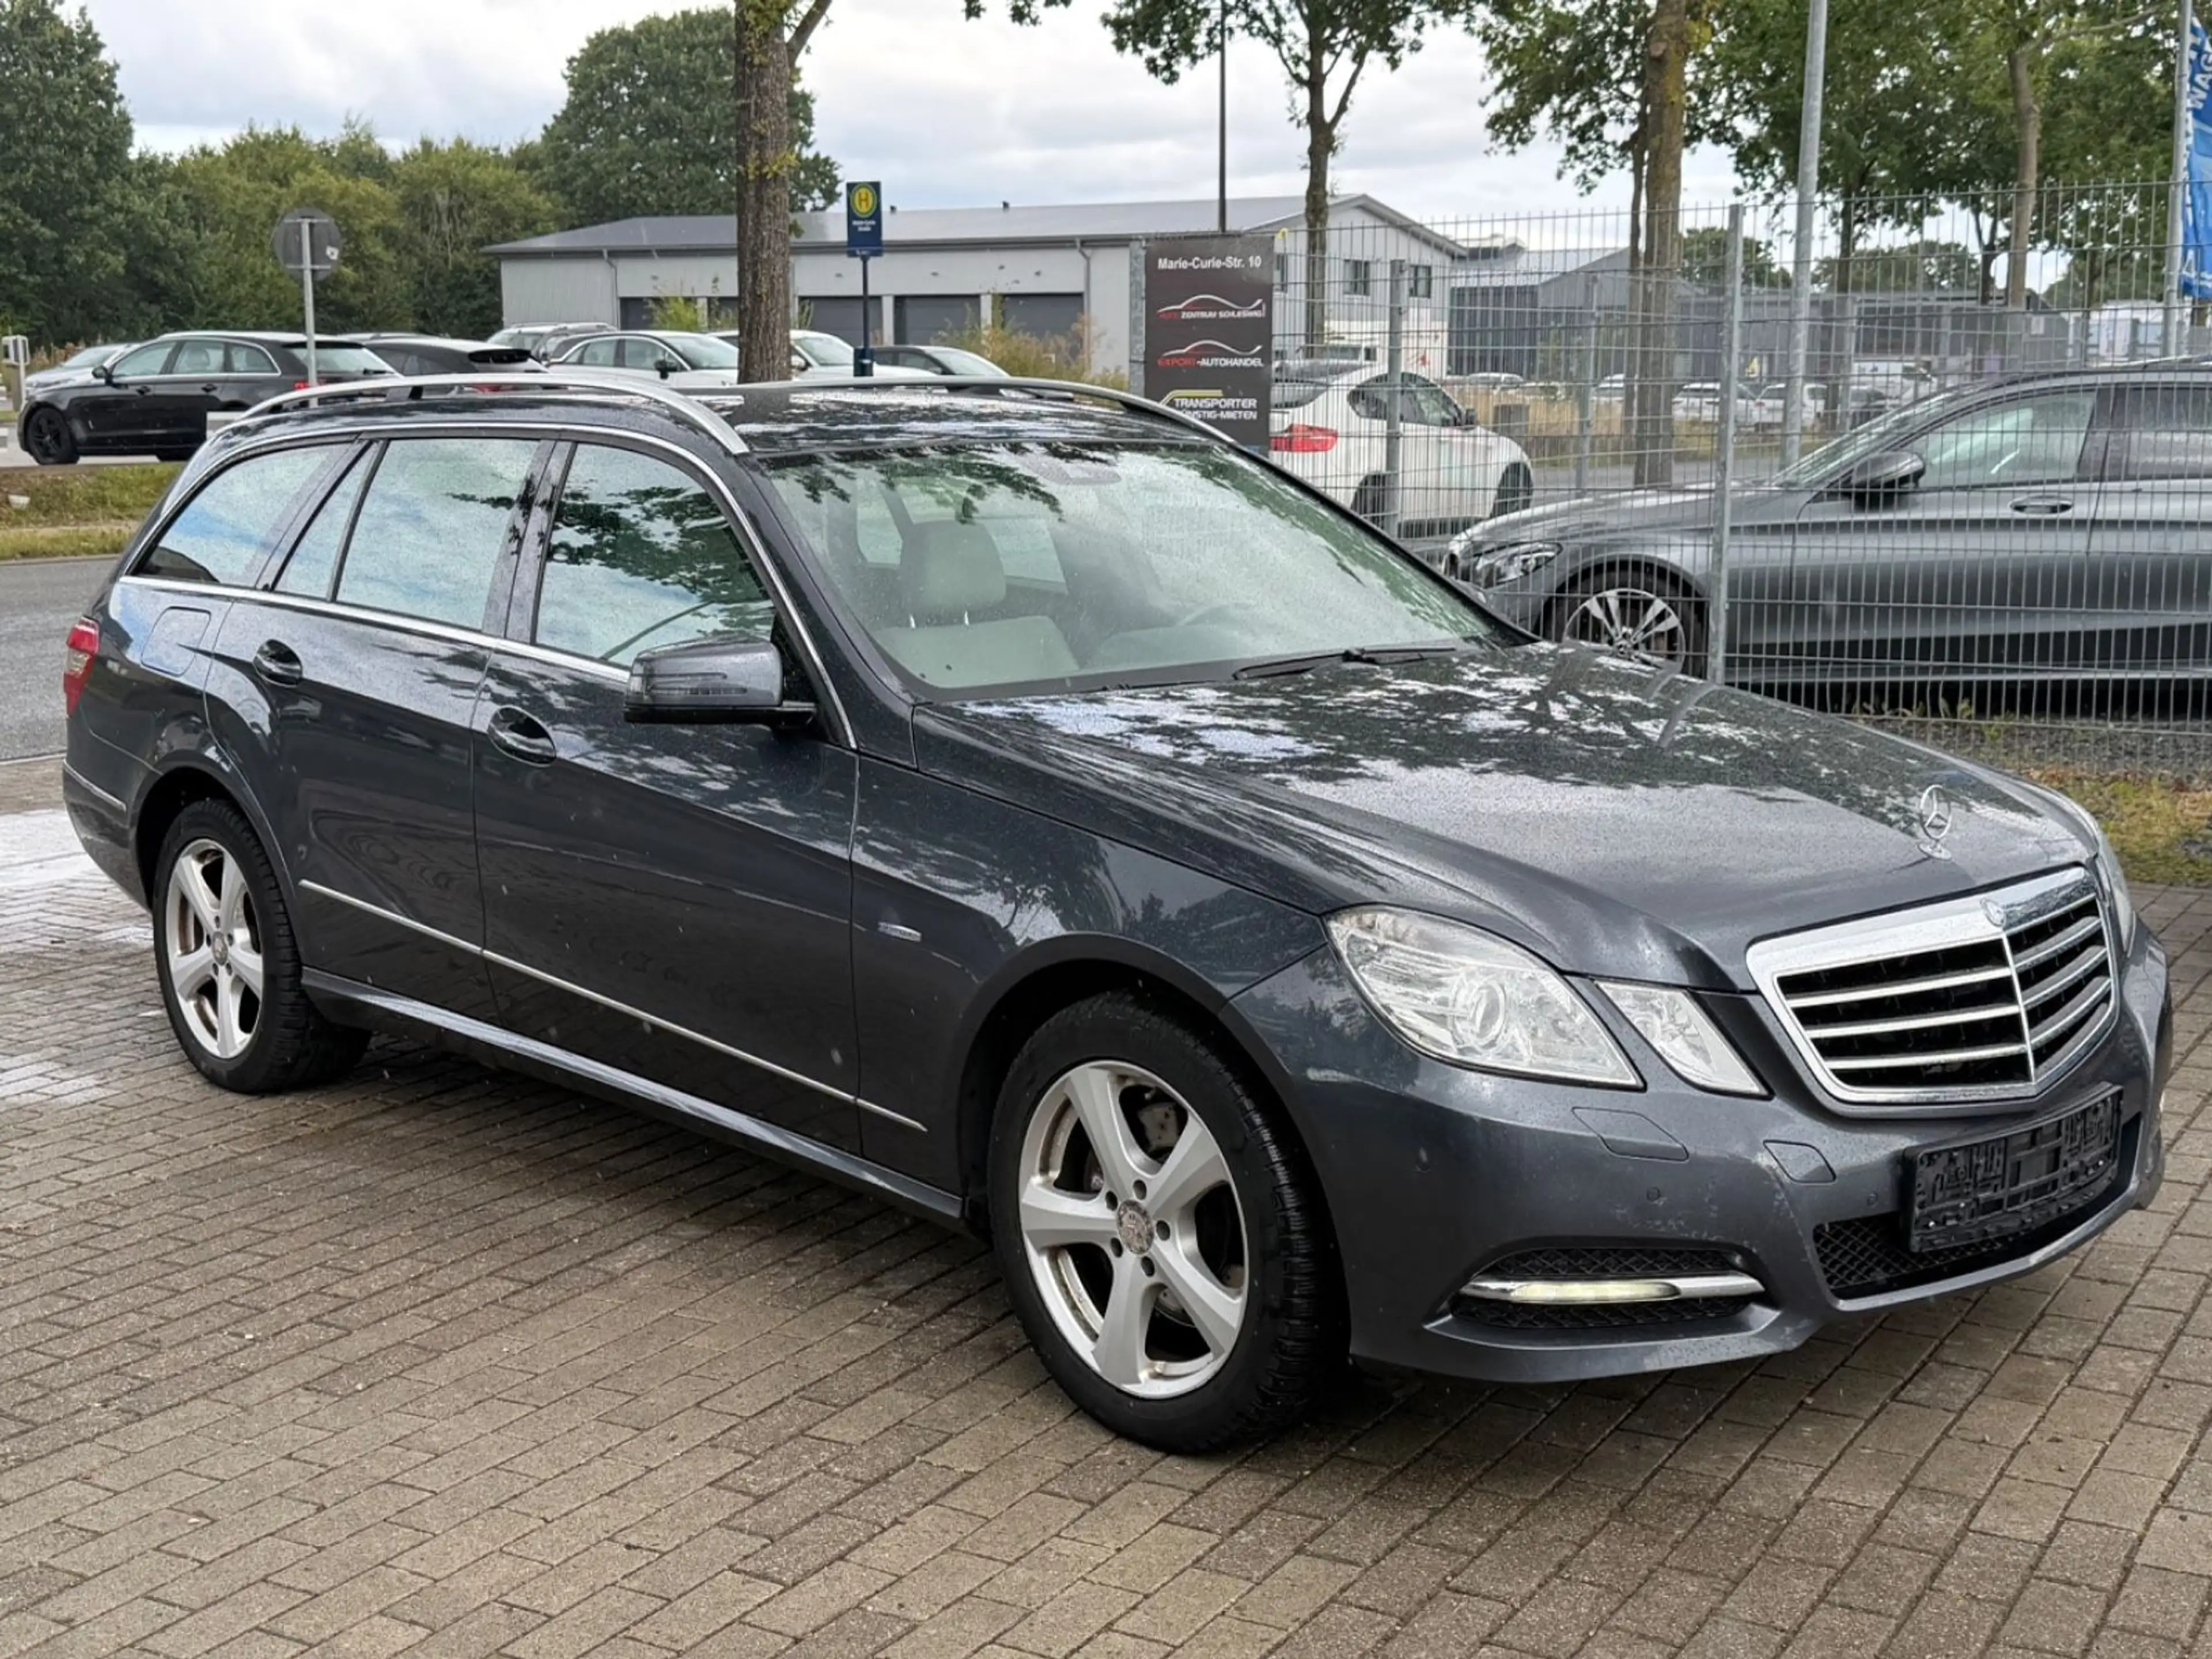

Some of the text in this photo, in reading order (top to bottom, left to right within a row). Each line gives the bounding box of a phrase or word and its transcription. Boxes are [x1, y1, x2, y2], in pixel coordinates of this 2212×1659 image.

[858, 192, 869, 209] H
[1158, 255, 1262, 270] Marie-Curie-Str. 10
[1174, 398, 1257, 409] TRANSPORTER
